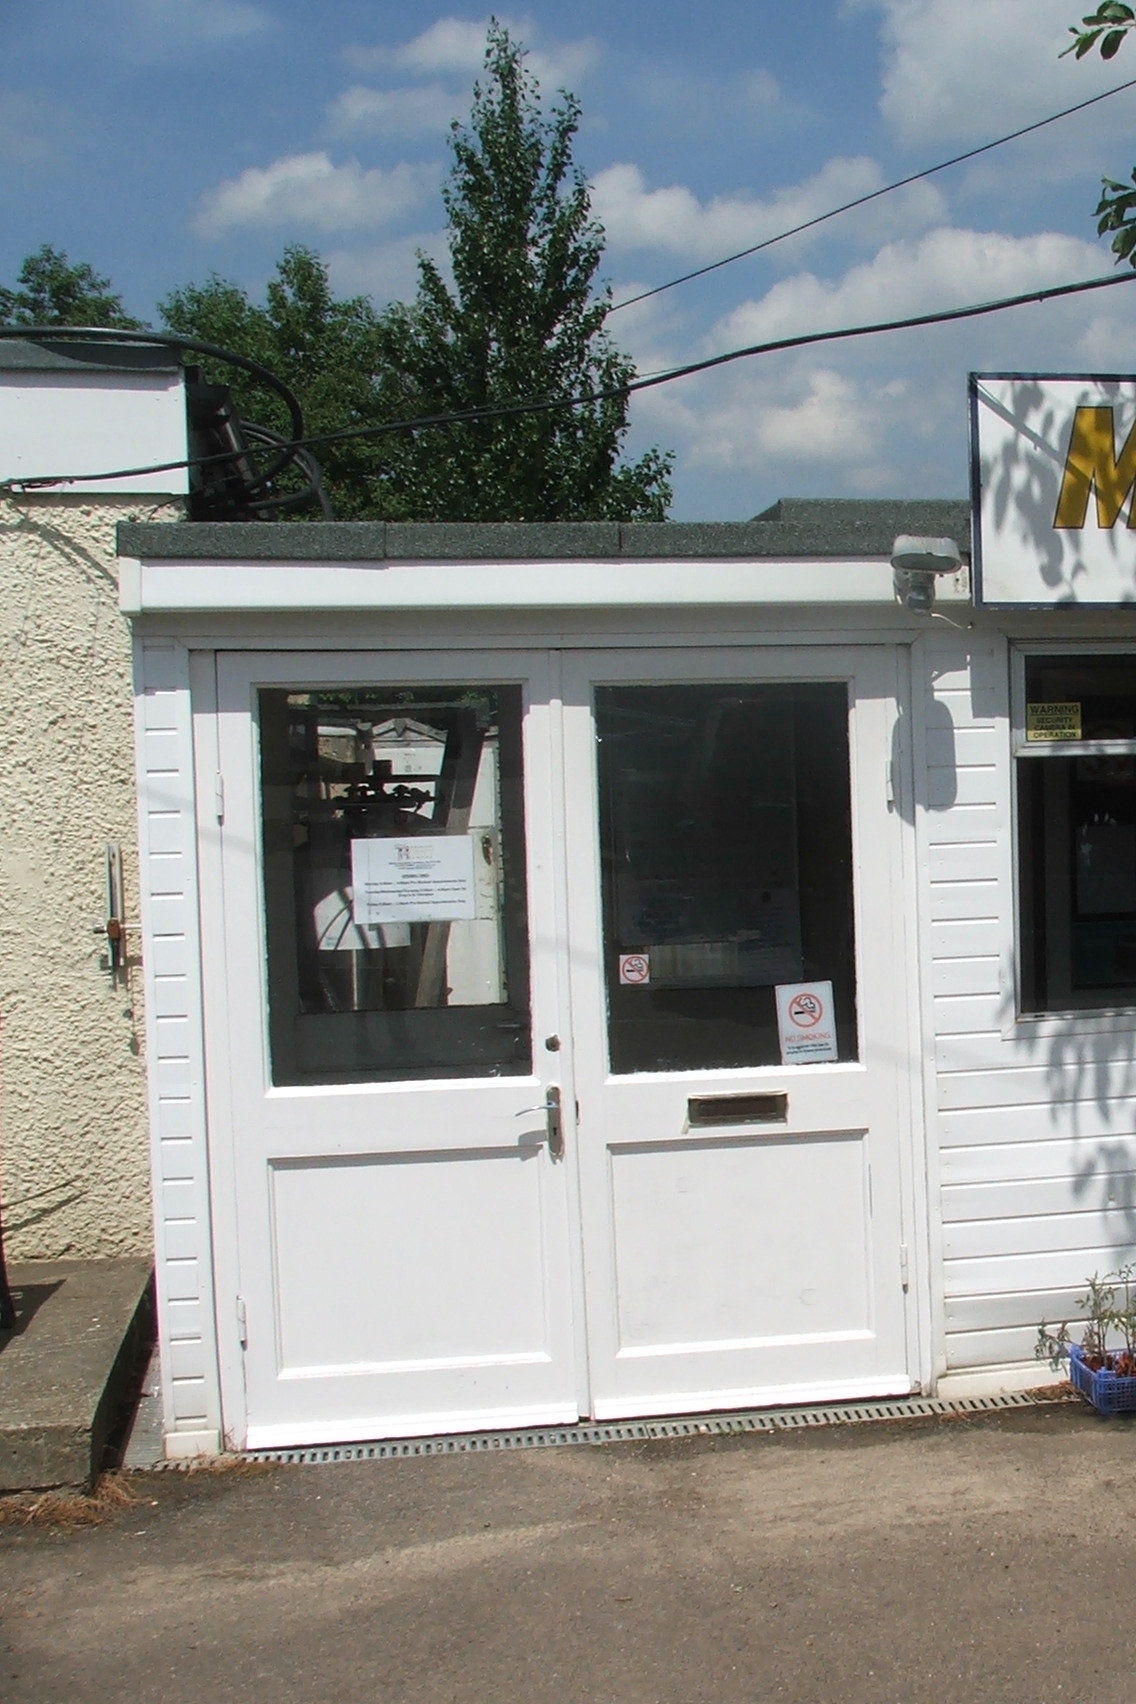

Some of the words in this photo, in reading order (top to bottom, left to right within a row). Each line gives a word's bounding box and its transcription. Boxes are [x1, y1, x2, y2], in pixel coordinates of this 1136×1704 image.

[1030, 704, 1079, 714] WARNING
[1036, 716, 1072, 724] SECURITY
[1033, 731, 1076, 739] OPERATION
[785, 1035, 796, 1043] NO
